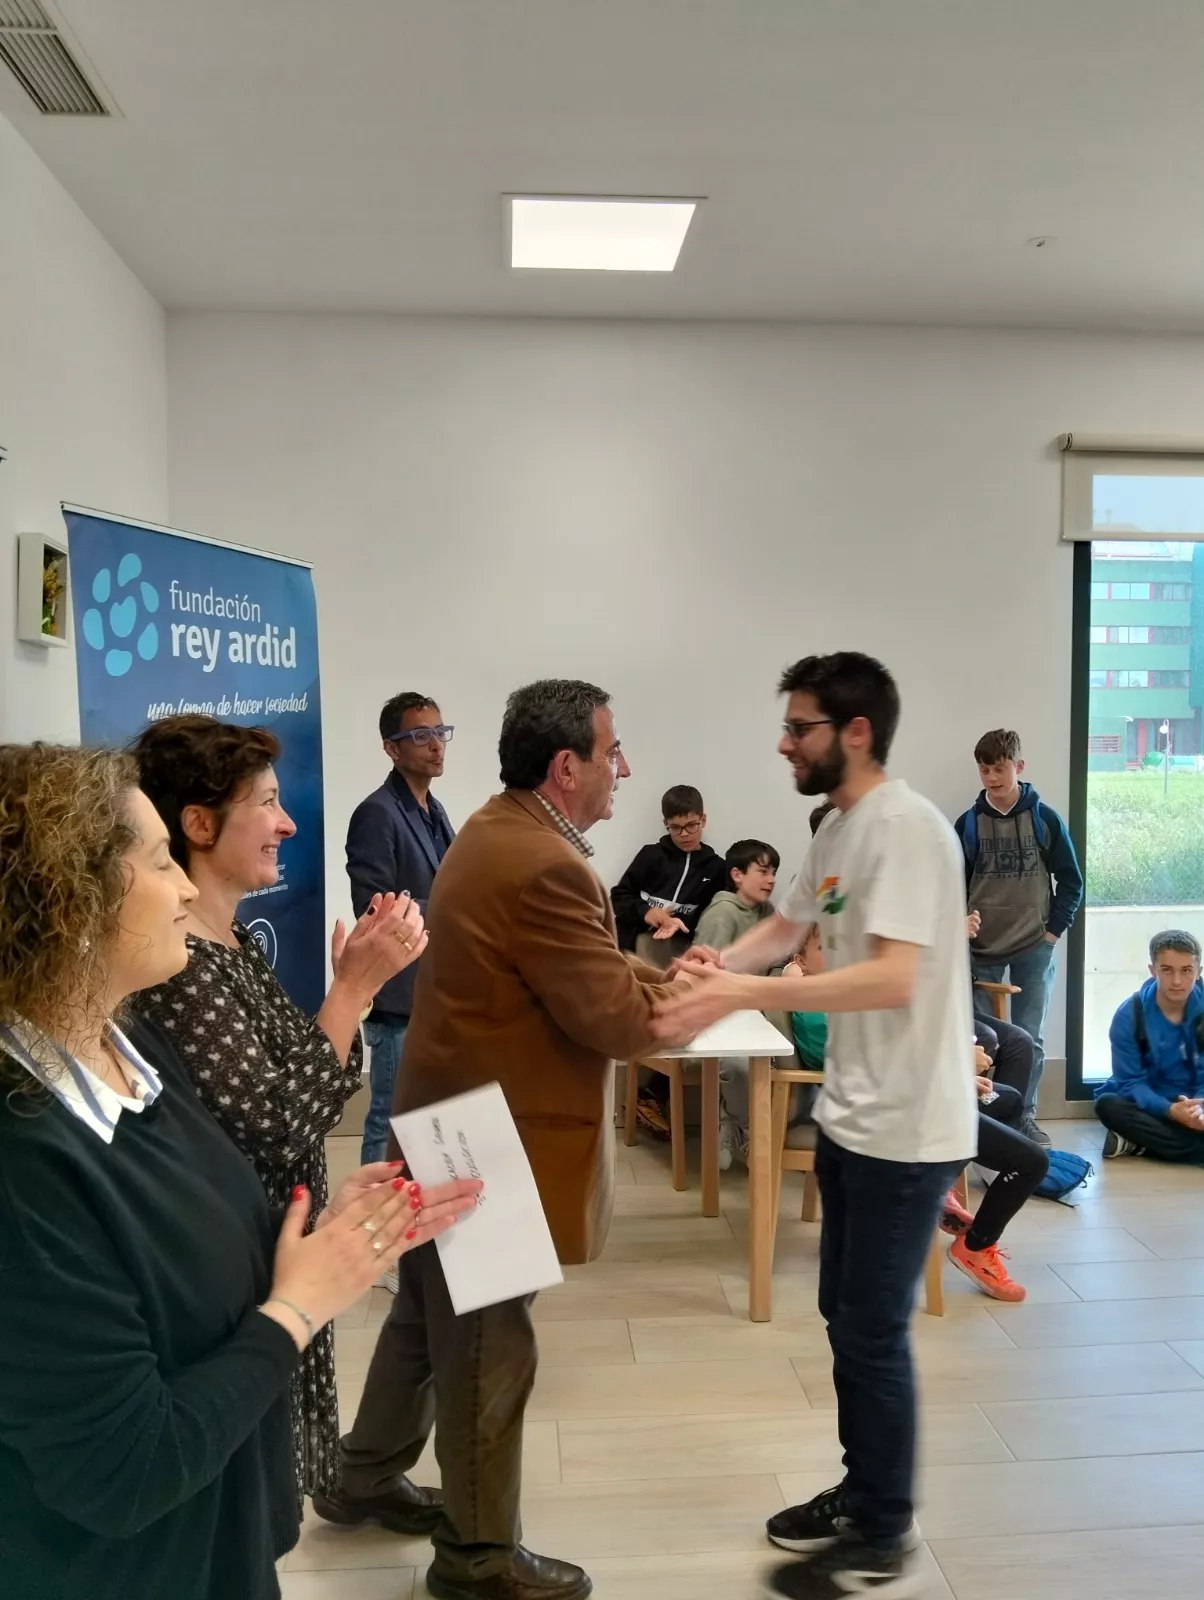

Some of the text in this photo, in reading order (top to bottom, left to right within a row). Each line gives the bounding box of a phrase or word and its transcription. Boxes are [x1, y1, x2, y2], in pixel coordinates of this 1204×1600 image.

[169, 580, 261, 622] fundación
[170, 623, 297, 673] rey ardid
[216, 694, 232, 716] de
[233, 692, 263, 716] hacer
[264, 692, 308, 715] sociedad
